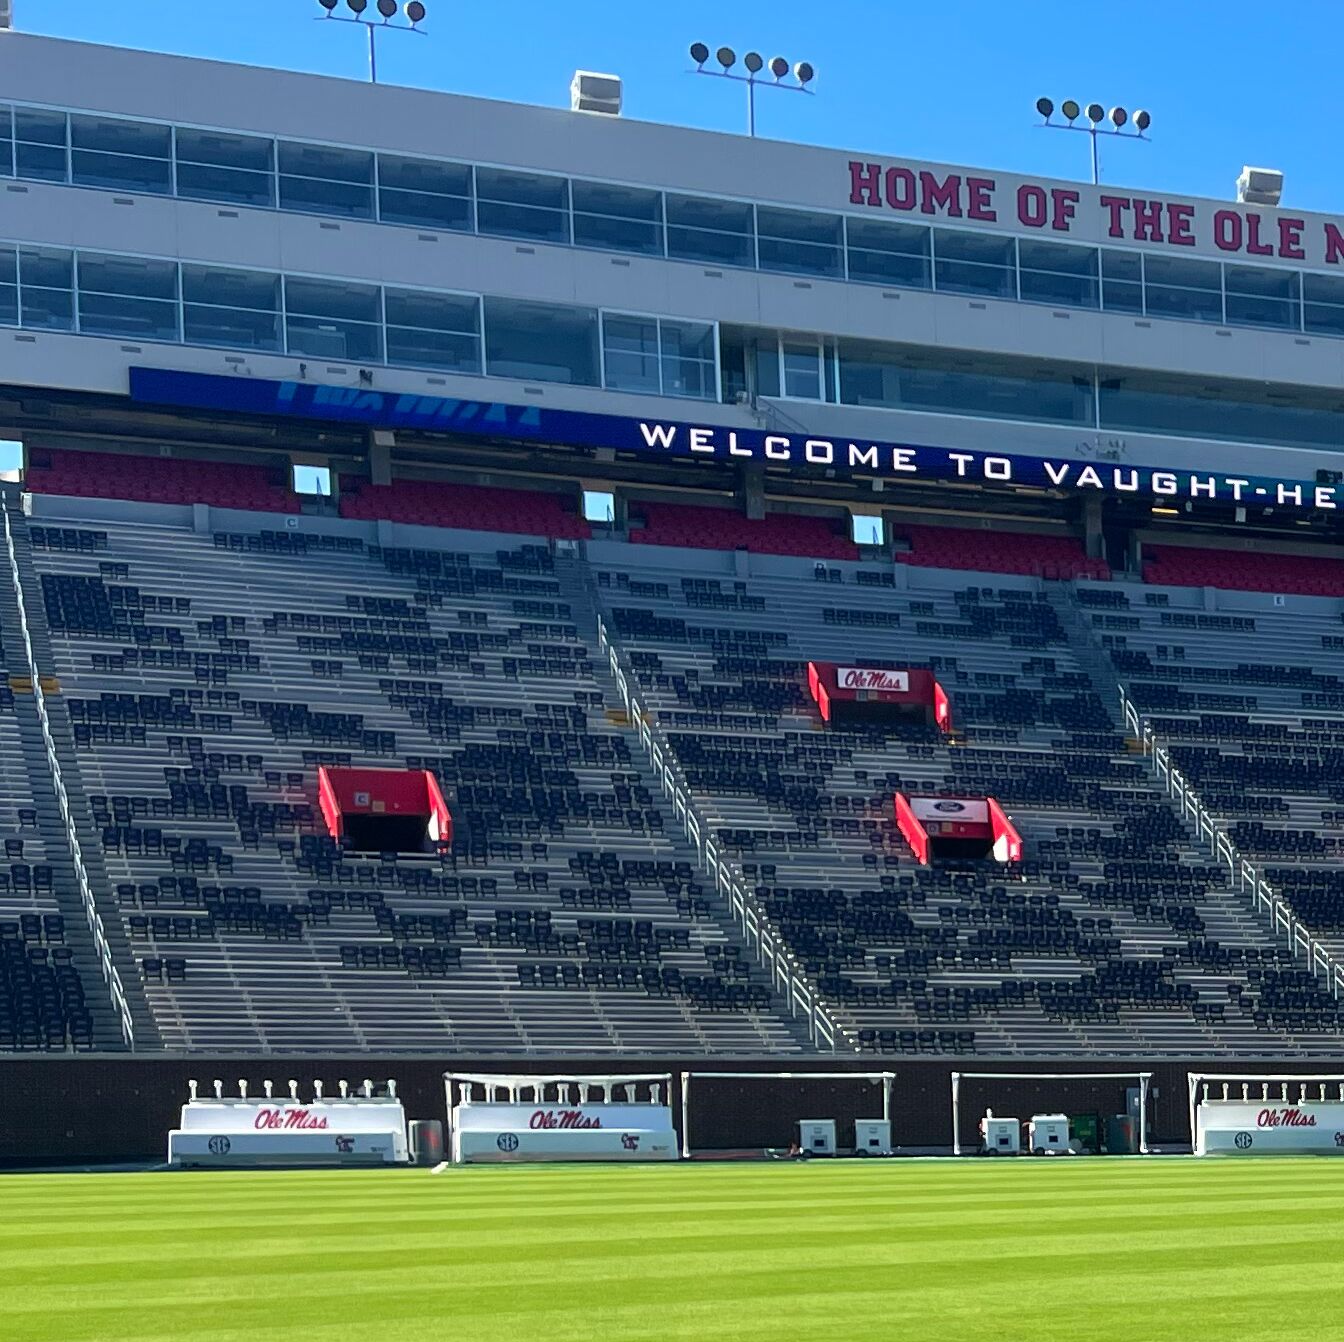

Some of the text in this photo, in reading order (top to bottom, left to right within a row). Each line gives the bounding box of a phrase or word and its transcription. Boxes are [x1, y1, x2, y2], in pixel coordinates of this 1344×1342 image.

[848, 160, 997, 223] HOME
[1016, 184, 1080, 232] OF
[1100, 194, 1196, 247] THE
[1213, 208, 1306, 260] OLE
[640, 422, 918, 473] WELCOME
[948, 453, 1012, 481] TO
[286, 518, 296, 527] C
[845, 670, 902, 690] Ole Miss
[254, 1108, 329, 1129] Ole Miss
[529, 1109, 602, 1130] Ole Miss
[1257, 1109, 1317, 1128] Ole Miss
[496, 1133, 517, 1151] SEC
[1235, 1132, 1253, 1149] SEC
